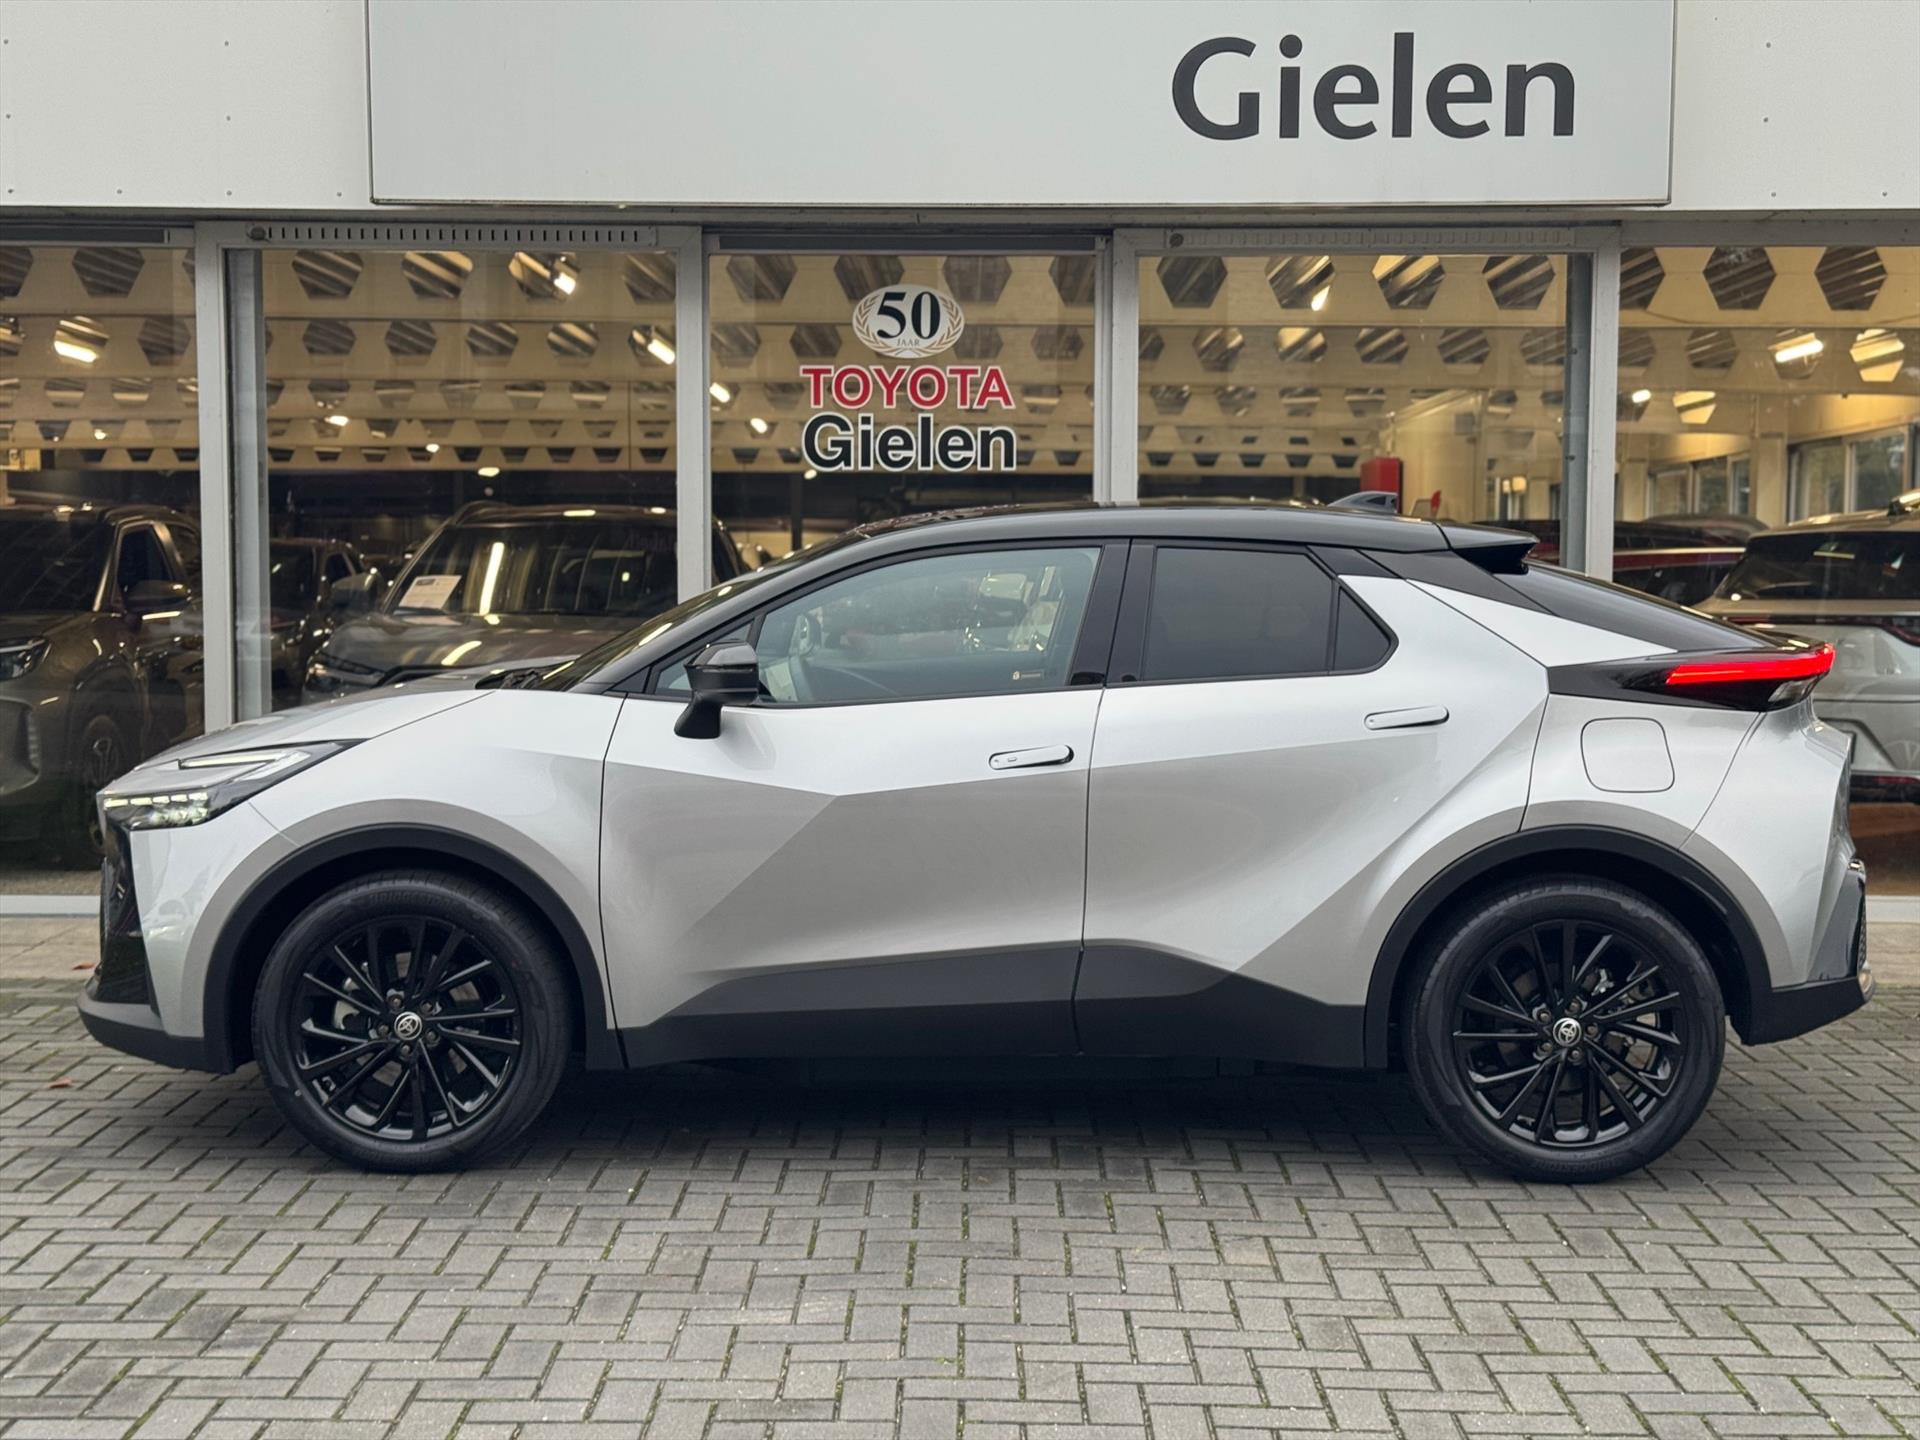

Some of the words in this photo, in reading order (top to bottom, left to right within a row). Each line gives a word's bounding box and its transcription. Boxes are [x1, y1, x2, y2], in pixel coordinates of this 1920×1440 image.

[1172, 32, 1575, 140] Gielen
[877, 291, 941, 339] 50
[896, 338, 920, 347] JAAR
[801, 364, 1016, 410] TOYOTA
[802, 411, 1017, 472] Gielen
